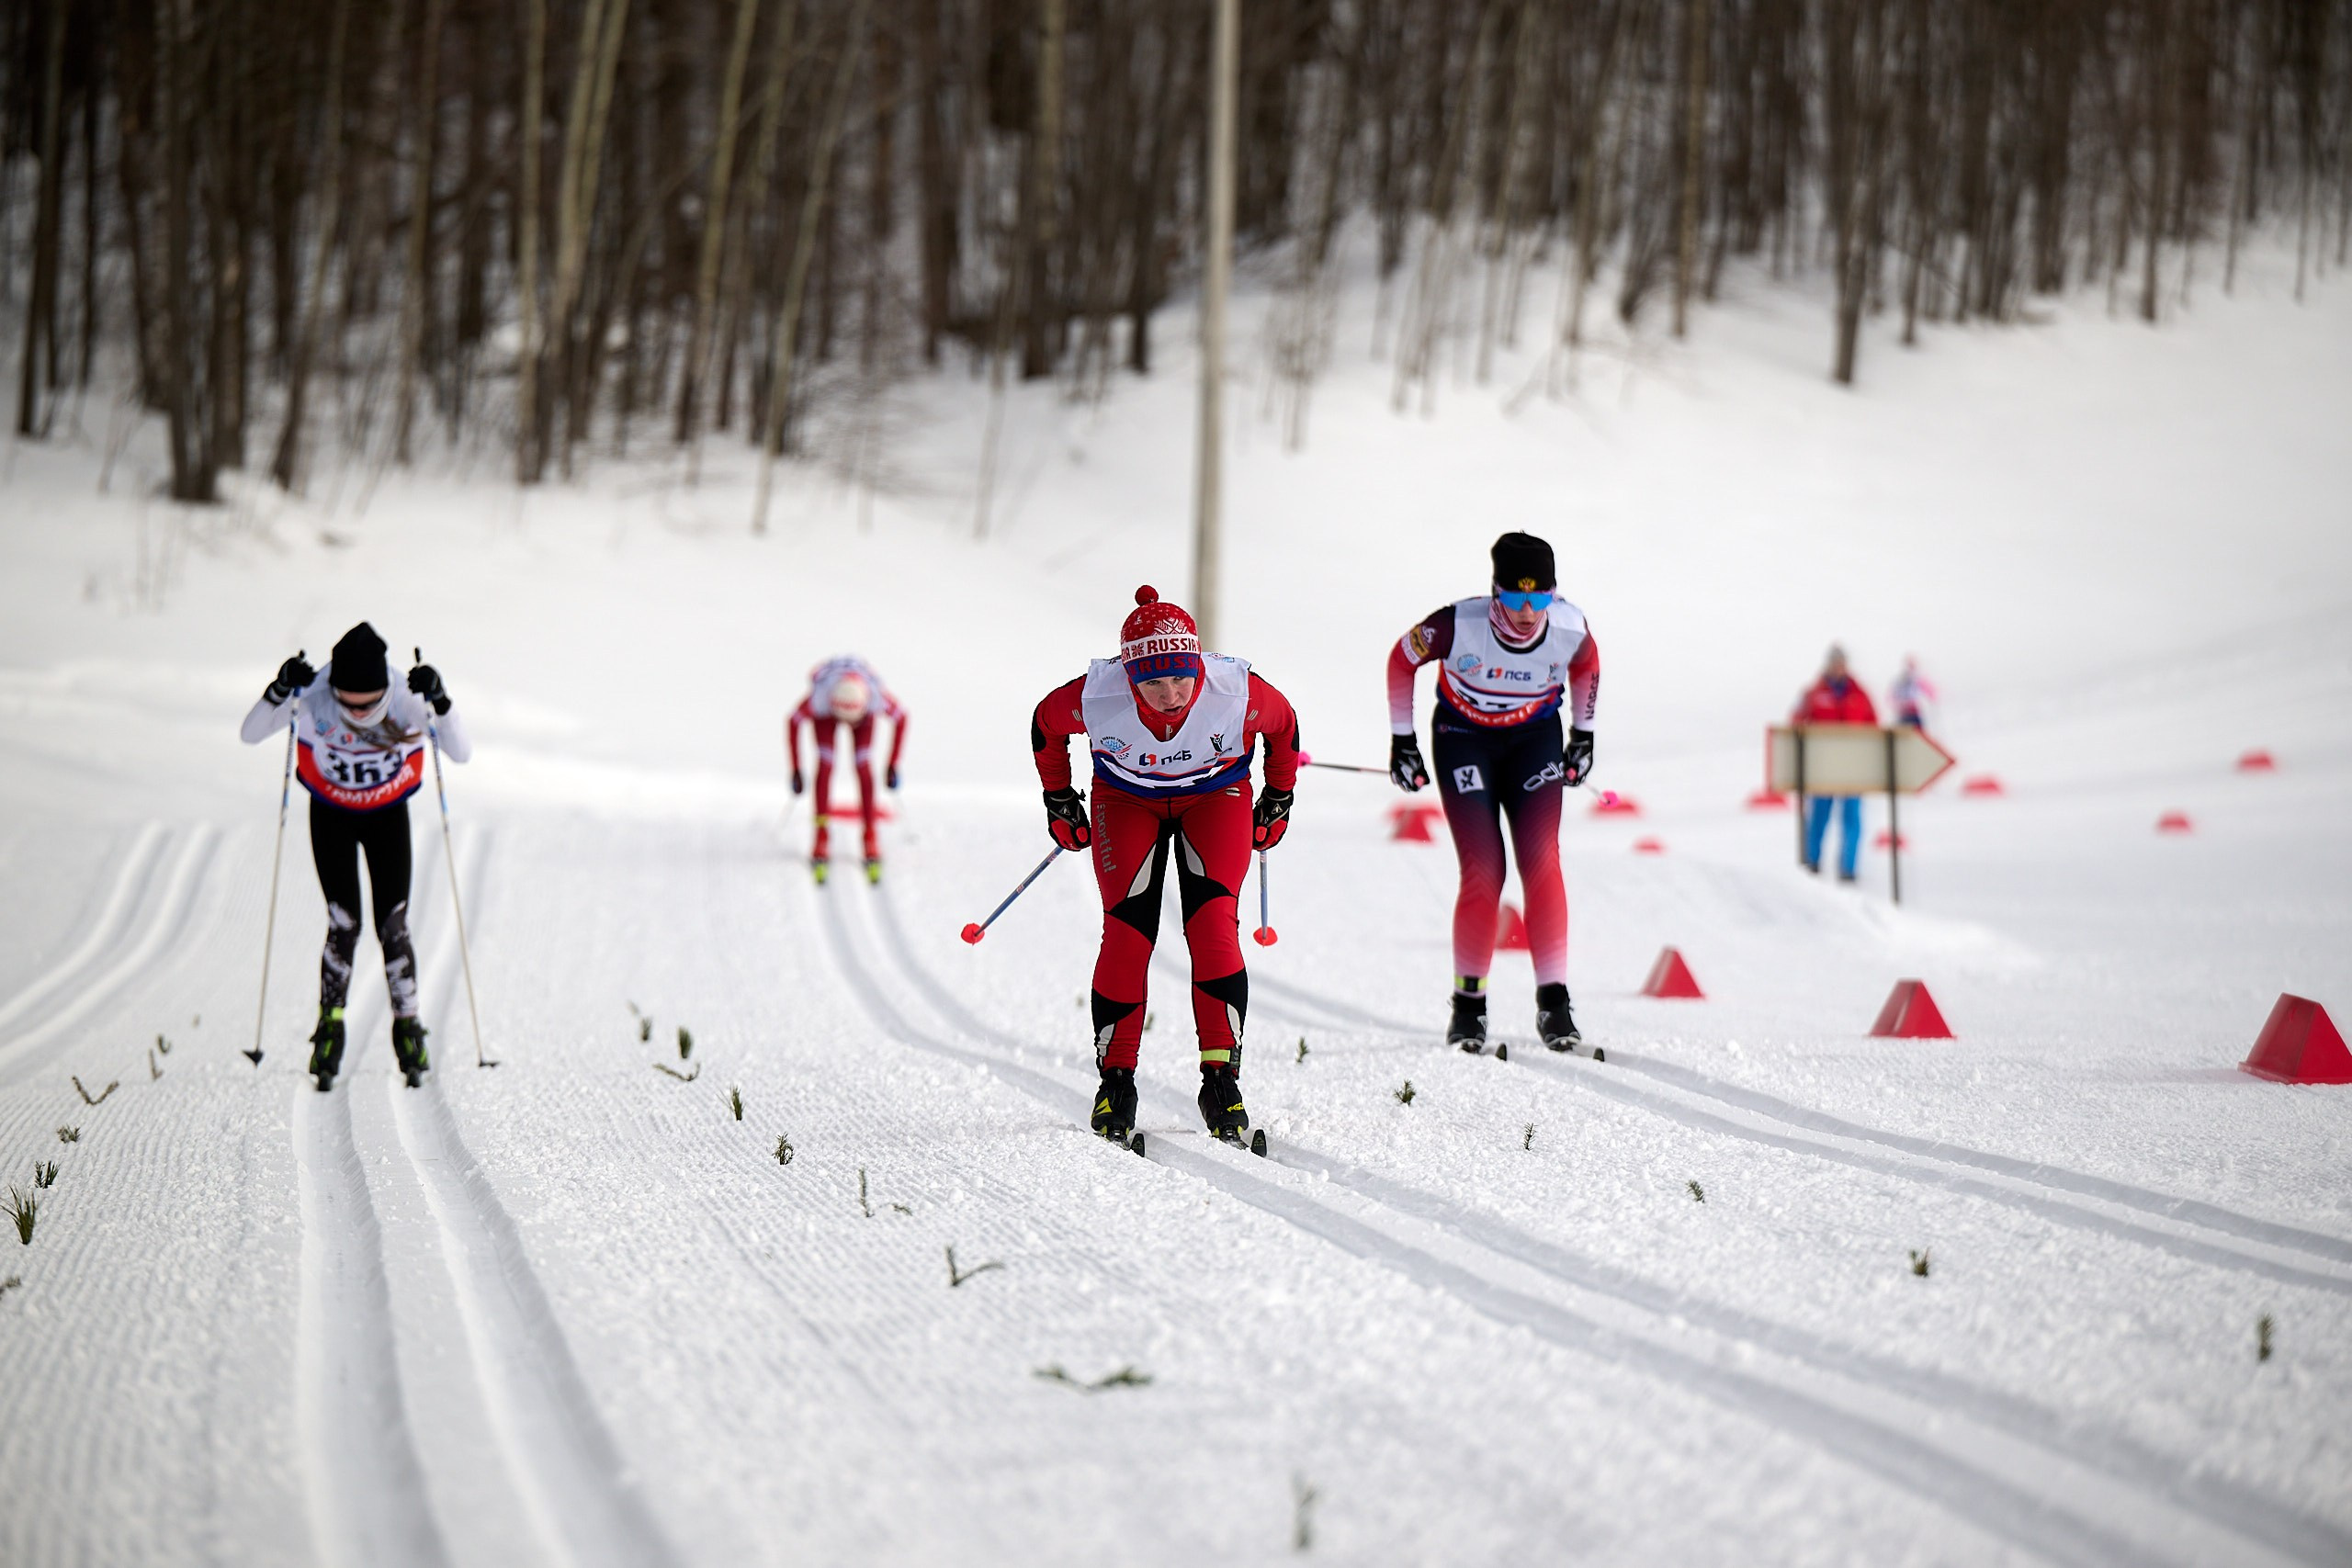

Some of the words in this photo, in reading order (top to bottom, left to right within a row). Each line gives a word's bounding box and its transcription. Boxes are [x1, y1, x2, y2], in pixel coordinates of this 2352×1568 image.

[1147, 637, 1197, 654] RUSSIA
[1505, 671, 1532, 681] ПСБ
[1161, 750, 1193, 765] ПСБ
[1096, 803, 1117, 873] sportful
